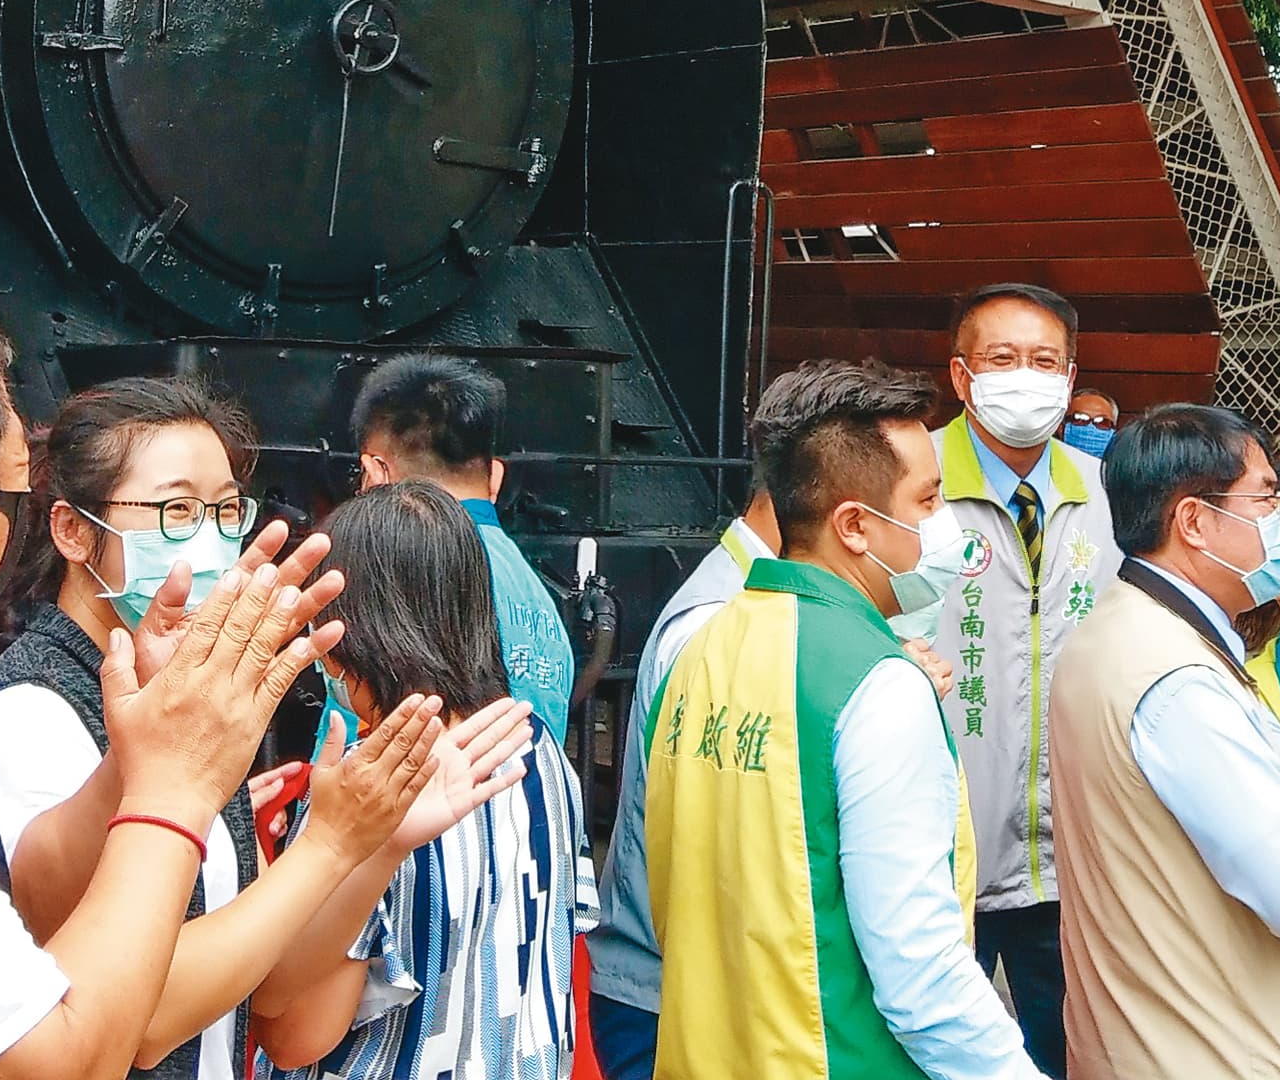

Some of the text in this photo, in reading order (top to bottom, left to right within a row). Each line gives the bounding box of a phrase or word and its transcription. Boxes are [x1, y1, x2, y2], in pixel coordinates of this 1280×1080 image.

[958, 580, 988, 738] 台南市議員
